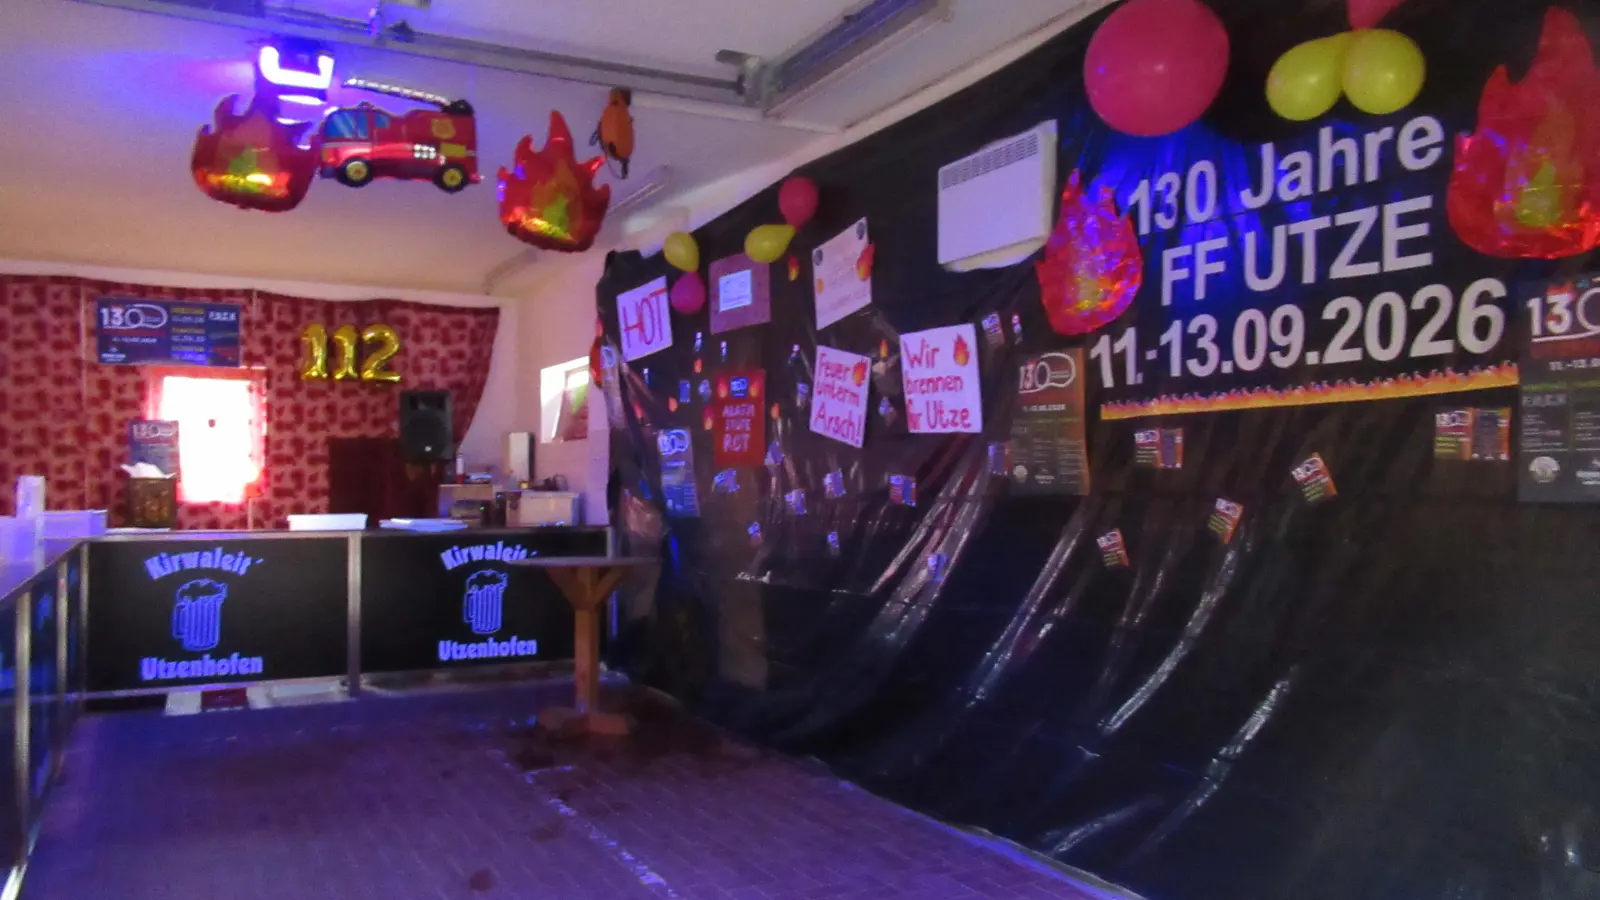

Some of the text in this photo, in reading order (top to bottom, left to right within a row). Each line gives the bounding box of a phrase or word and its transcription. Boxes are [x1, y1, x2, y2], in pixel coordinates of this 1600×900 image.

[1129, 114, 1444, 235] 130 Jahre
[1161, 196, 1433, 306] FF UTZE
[622, 287, 668, 348] HOT
[1091, 278, 1507, 388] 11.-13.09.2026
[302, 323, 401, 383] 112
[819, 352, 850, 382] Feuer
[903, 337, 939, 368] Wir
[813, 401, 861, 445] Arsch!
[926, 399, 972, 430] Utze
[141, 652, 263, 681] Utzenhofen
[438, 635, 537, 661] Utzenhofen
